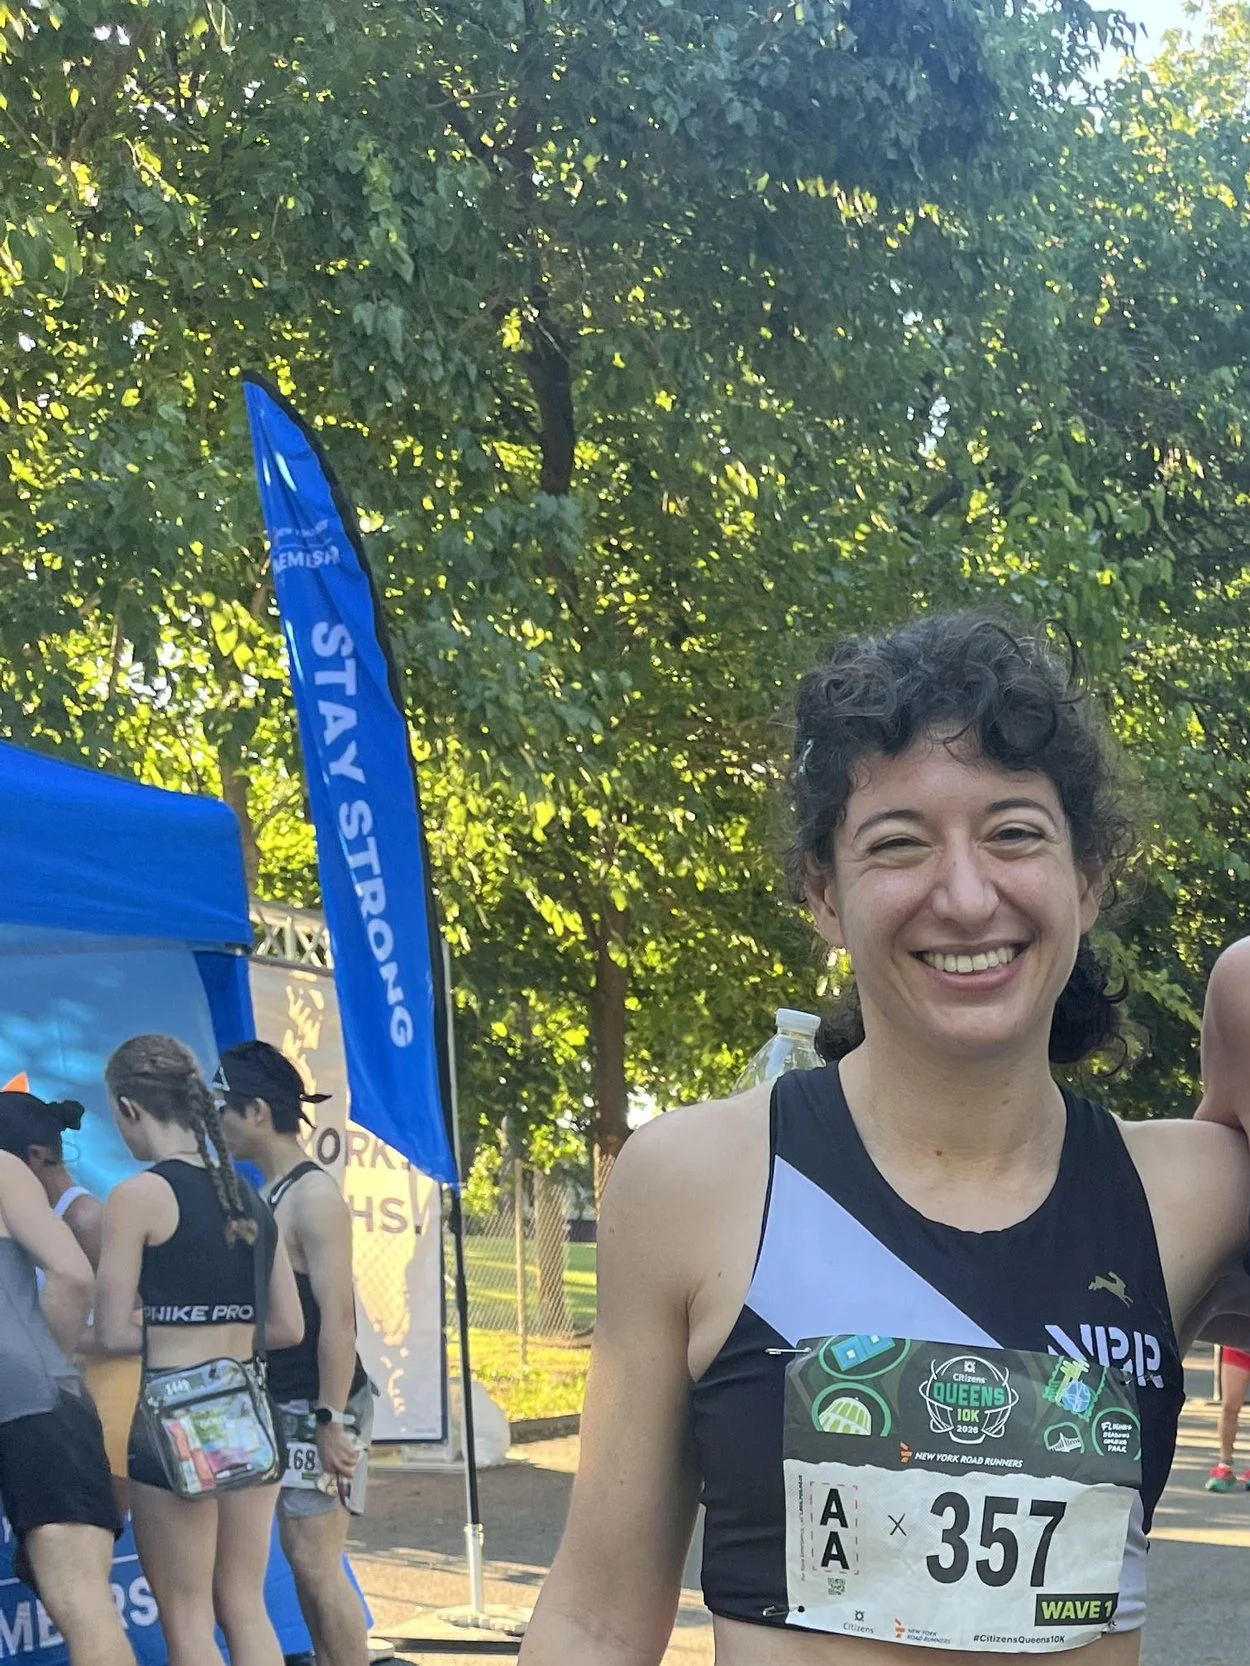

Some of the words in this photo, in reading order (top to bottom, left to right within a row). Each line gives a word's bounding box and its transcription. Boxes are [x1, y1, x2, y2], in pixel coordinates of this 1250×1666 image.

[311, 621, 366, 785] STAY
[339, 800, 413, 1048] STRONG
[152, 1305, 209, 1322] NIKE
[212, 1304, 254, 1321] PRO
[953, 1373, 986, 1384] Citizens
[933, 1382, 1006, 1407] QUEENS
[957, 1408, 979, 1422] 10K
[914, 1452, 937, 1462] NEW
[936, 1453, 959, 1463] YORK
[960, 1456, 984, 1466] ROAD
[984, 1458, 1024, 1469] RUNNERS
[926, 1491, 1067, 1587] 357
[1041, 1600, 1101, 1620] WAVE
[1103, 1600, 1112, 1618] 1
[843, 1622, 874, 1634] Citizens
[973, 1634, 1065, 1644] #CitizensQueens10K
